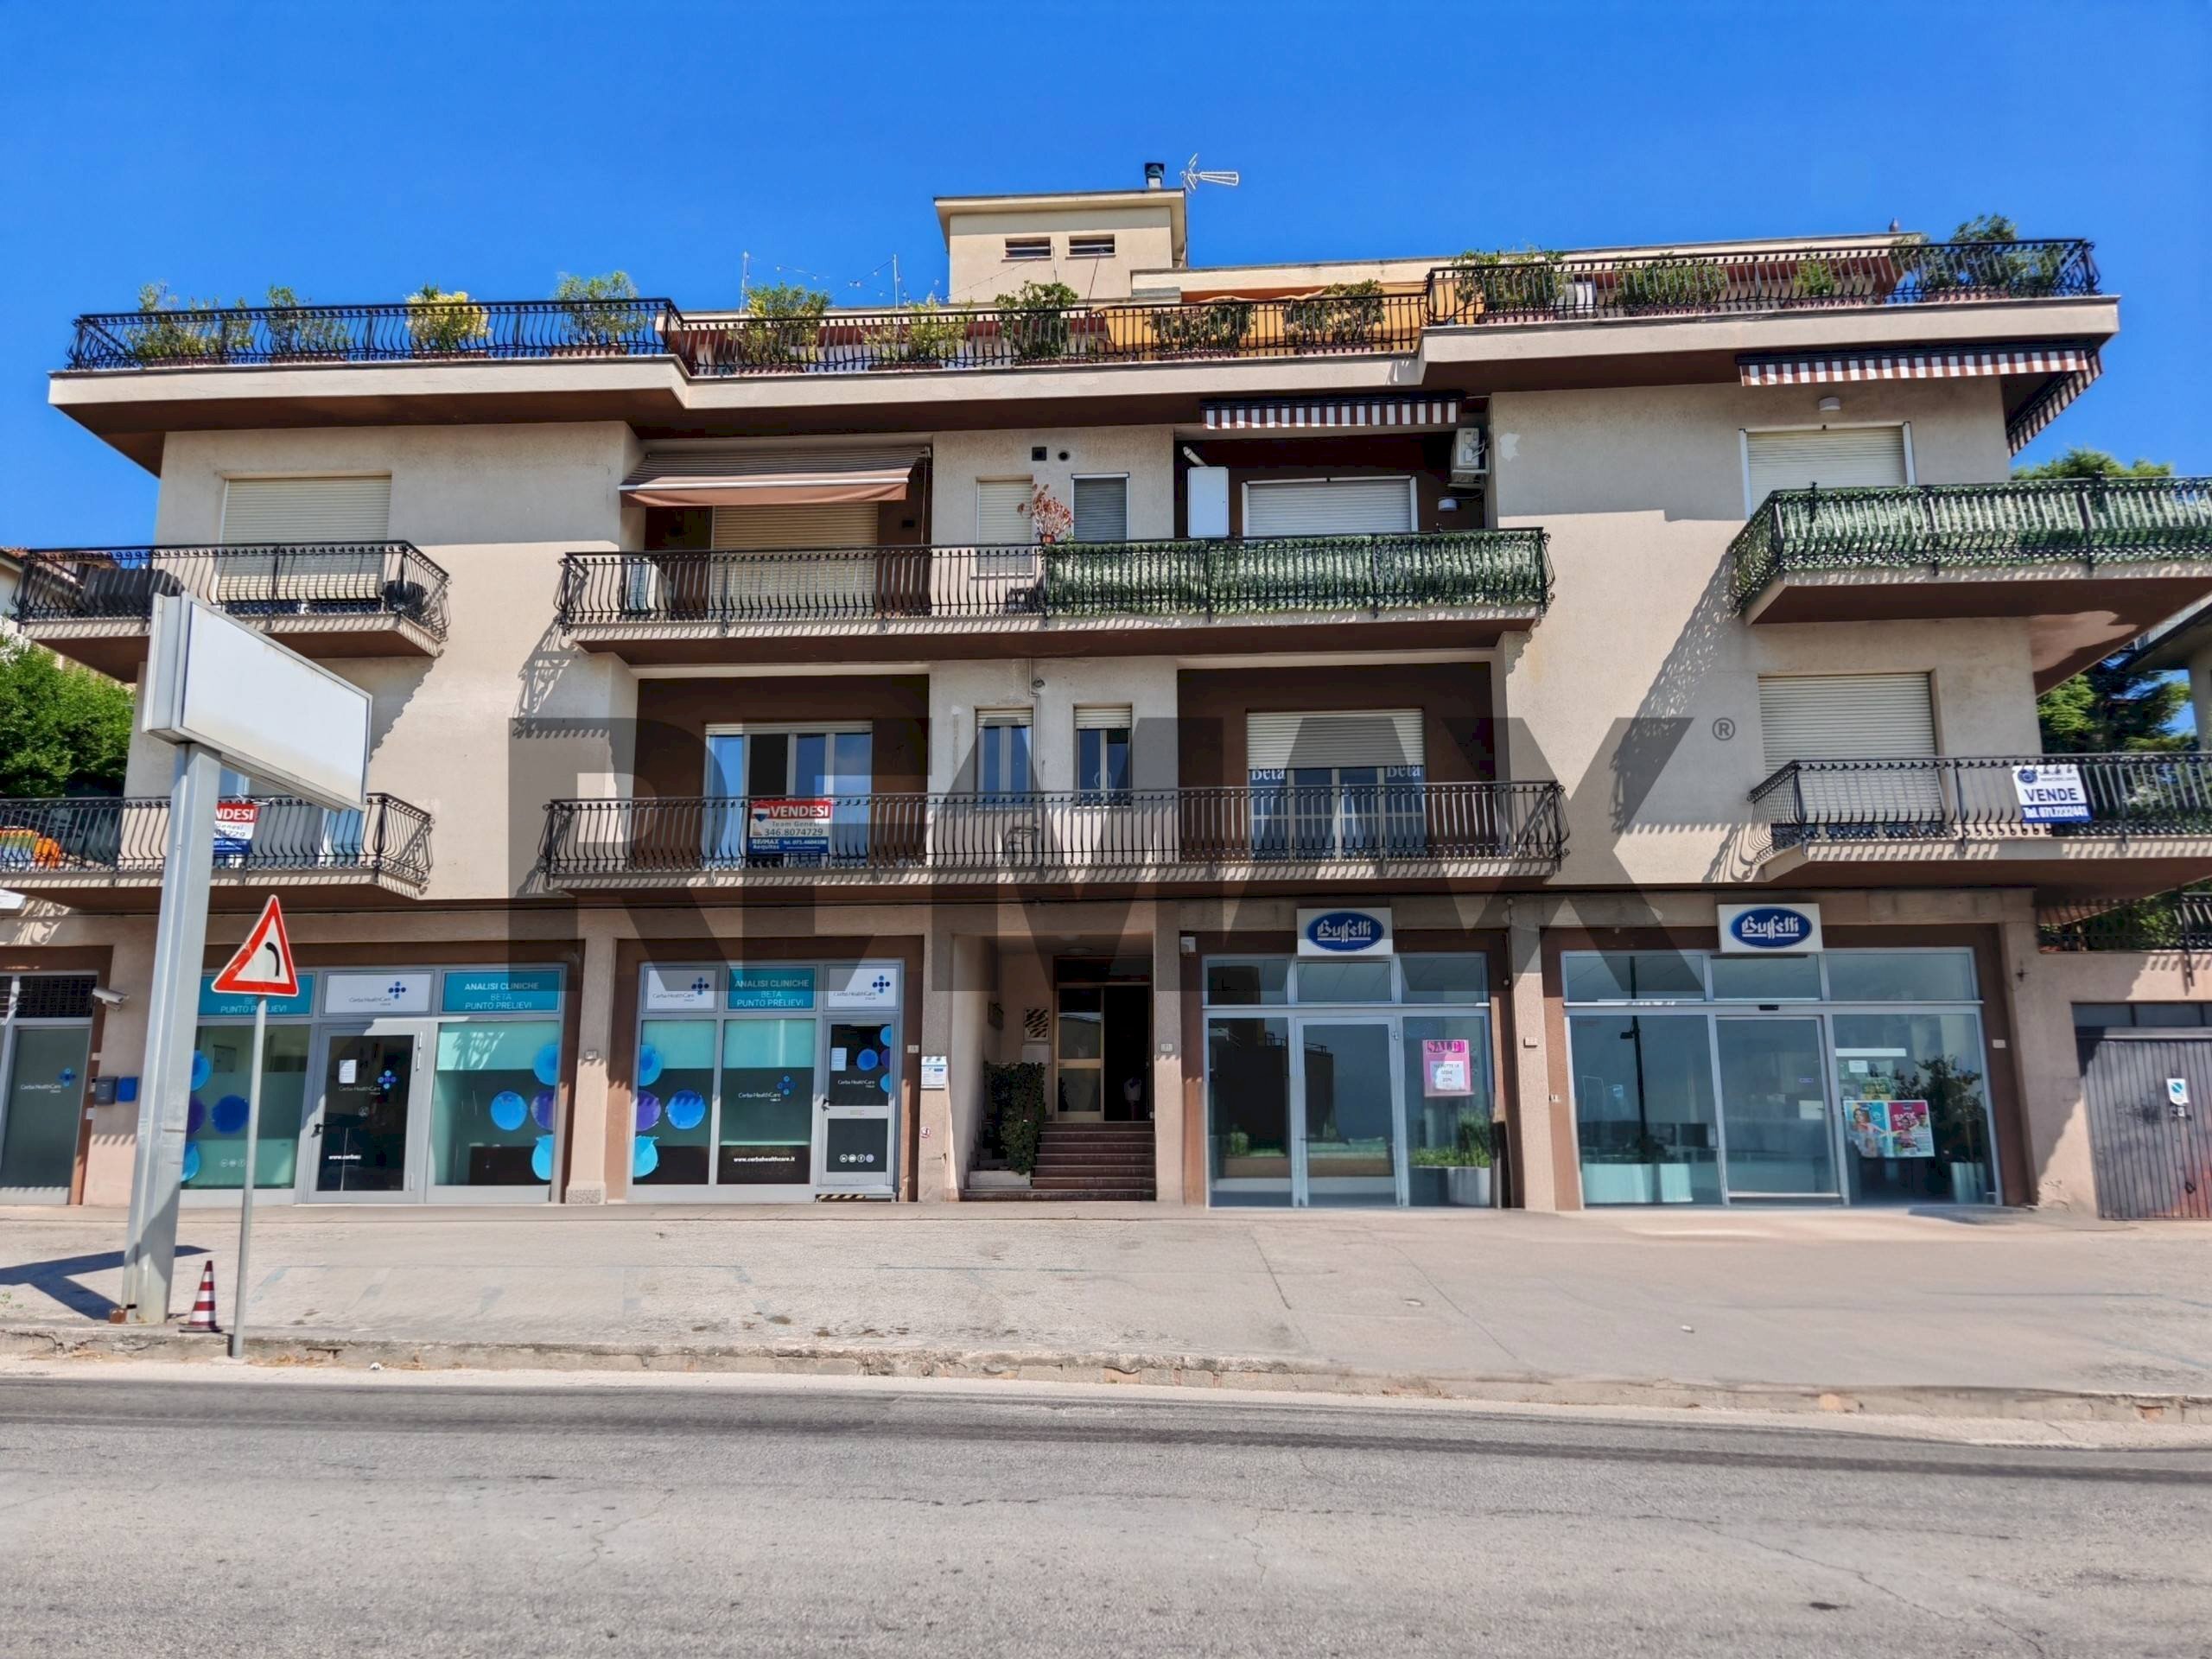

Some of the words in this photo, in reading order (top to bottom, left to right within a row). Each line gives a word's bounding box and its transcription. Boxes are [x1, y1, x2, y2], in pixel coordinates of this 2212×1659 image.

[2024, 788, 2079, 802] VENDE
[770, 805, 830, 817] VENDESI
[1317, 919, 1371, 943] Buffetti
[1741, 915, 1800, 939] Buffetti
[500, 982, 540, 990] CLINICHE
[770, 979, 810, 988] CLINICHE
